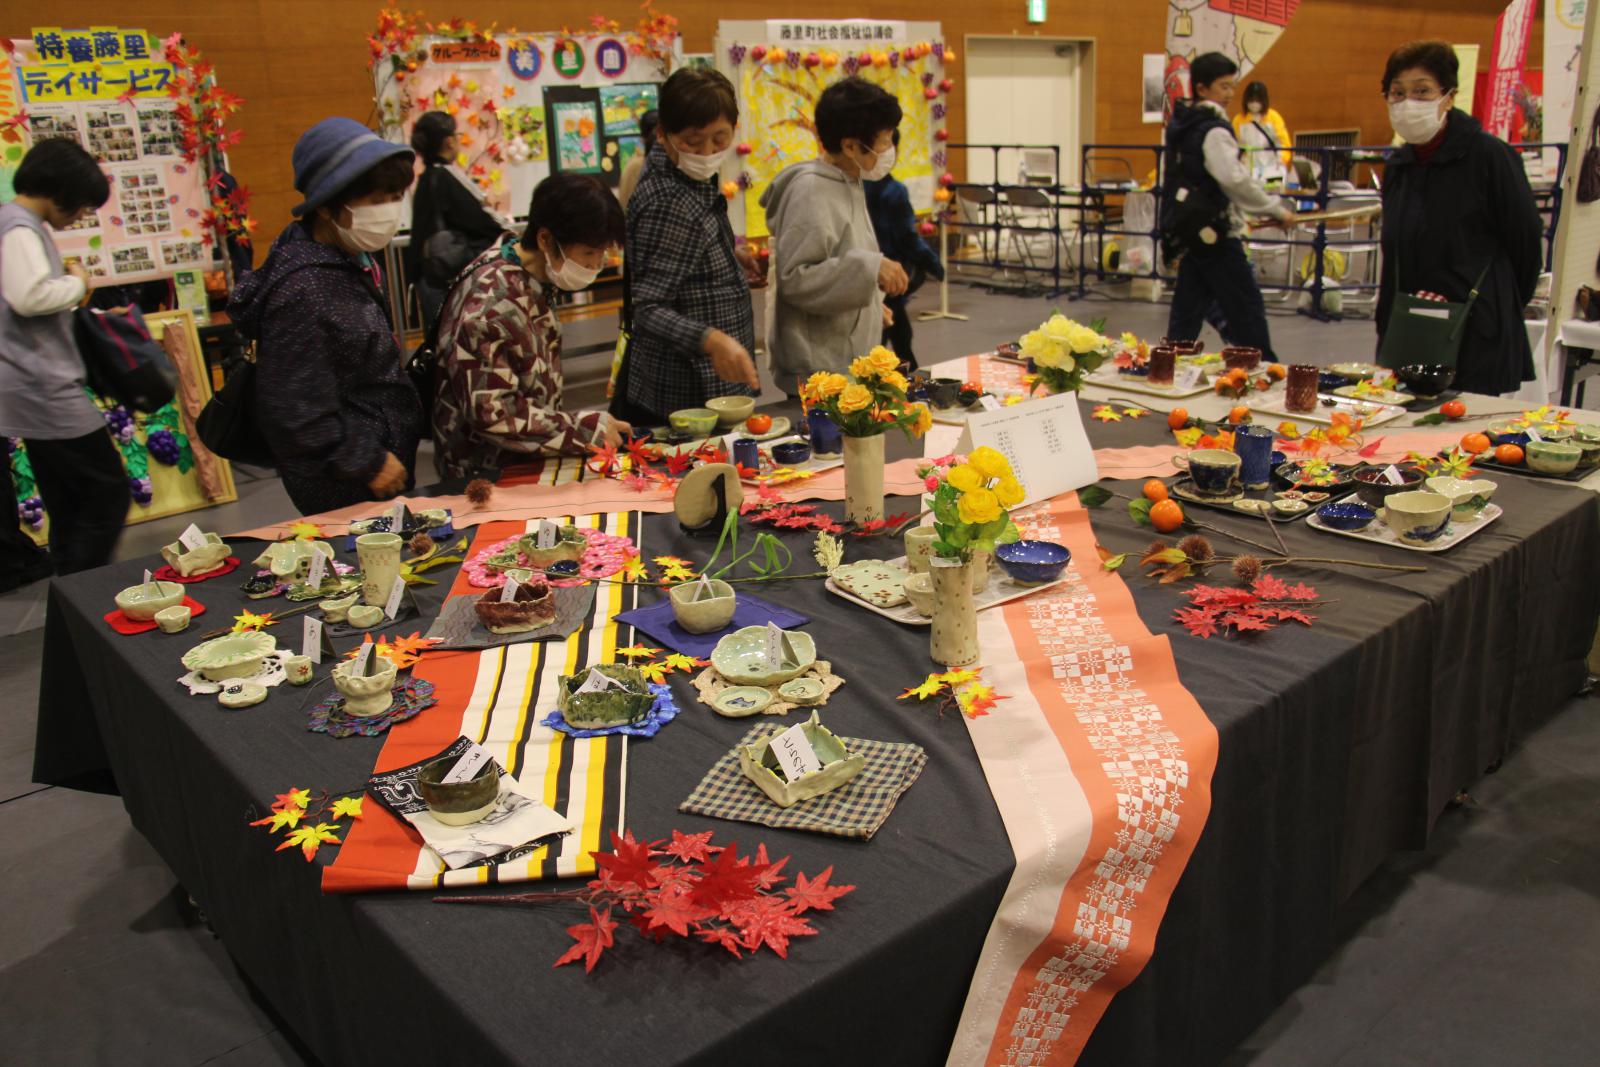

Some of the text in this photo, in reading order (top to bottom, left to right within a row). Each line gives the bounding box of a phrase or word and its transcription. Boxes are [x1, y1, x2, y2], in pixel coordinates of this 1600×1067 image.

[780, 25, 893, 40] 藤里町社会福祉協議会
[35, 31, 149, 62] 特養藤里
[432, 48, 500, 59] グループホーム
[25, 68, 171, 96] デイサービス
